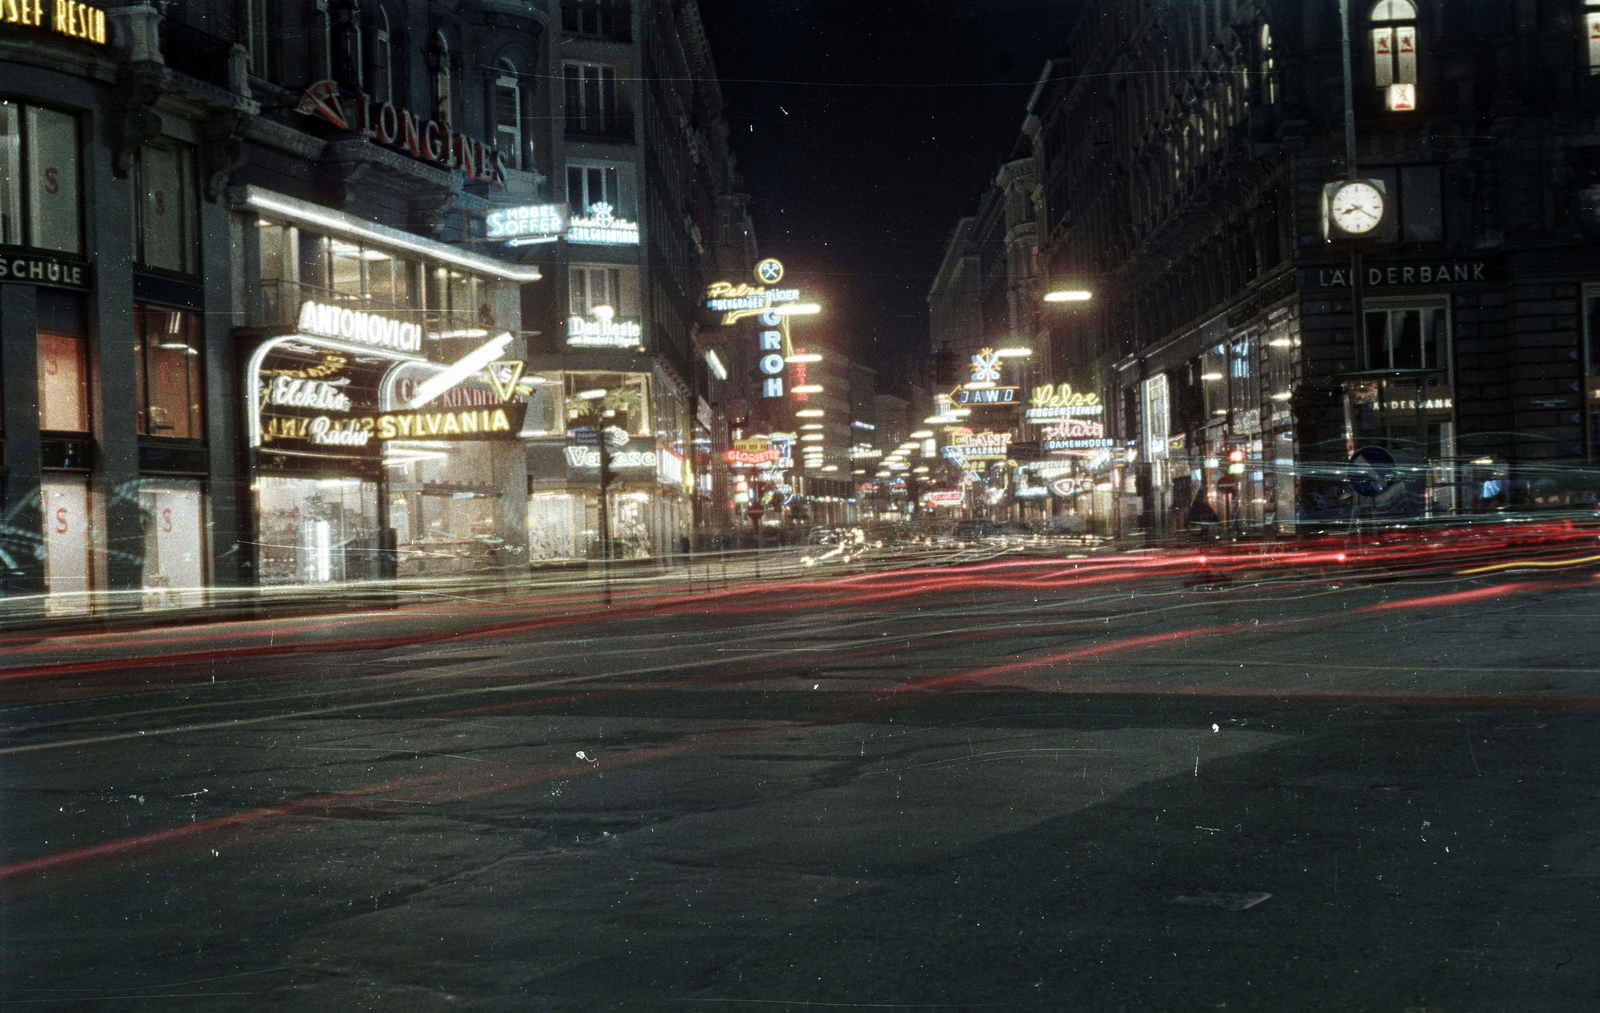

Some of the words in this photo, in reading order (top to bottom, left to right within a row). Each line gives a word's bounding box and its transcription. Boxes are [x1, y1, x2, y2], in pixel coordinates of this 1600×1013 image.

[0, 0, 43, 26] SEF
[56, 0, 106, 44] RESCH
[361, 92, 508, 187] LONGINES
[45, 167, 59, 194] S
[154, 190, 166, 216] S
[506, 205, 558, 220] MÖBEL
[491, 212, 562, 235] SOFFER
[709, 281, 766, 298] Pelze
[302, 301, 421, 350] ANTONOVICH
[569, 316, 600, 336] Das
[602, 318, 640, 337] Beste
[763, 306, 784, 398] GROH
[274, 376, 350, 411] Elektro
[961, 389, 1014, 403] JAWO
[1032, 383, 1100, 407] Pelze
[315, 416, 370, 446] Radio
[378, 408, 511, 439] SYLVANIA
[965, 433, 1013, 447] LANZ
[965, 446, 1007, 454] SALZBUR
[1049, 438, 1114, 449] DAMENMODEN
[727, 448, 781, 464] GLORIETTE
[56, 507, 69, 534] S
[162, 508, 173, 533] S
